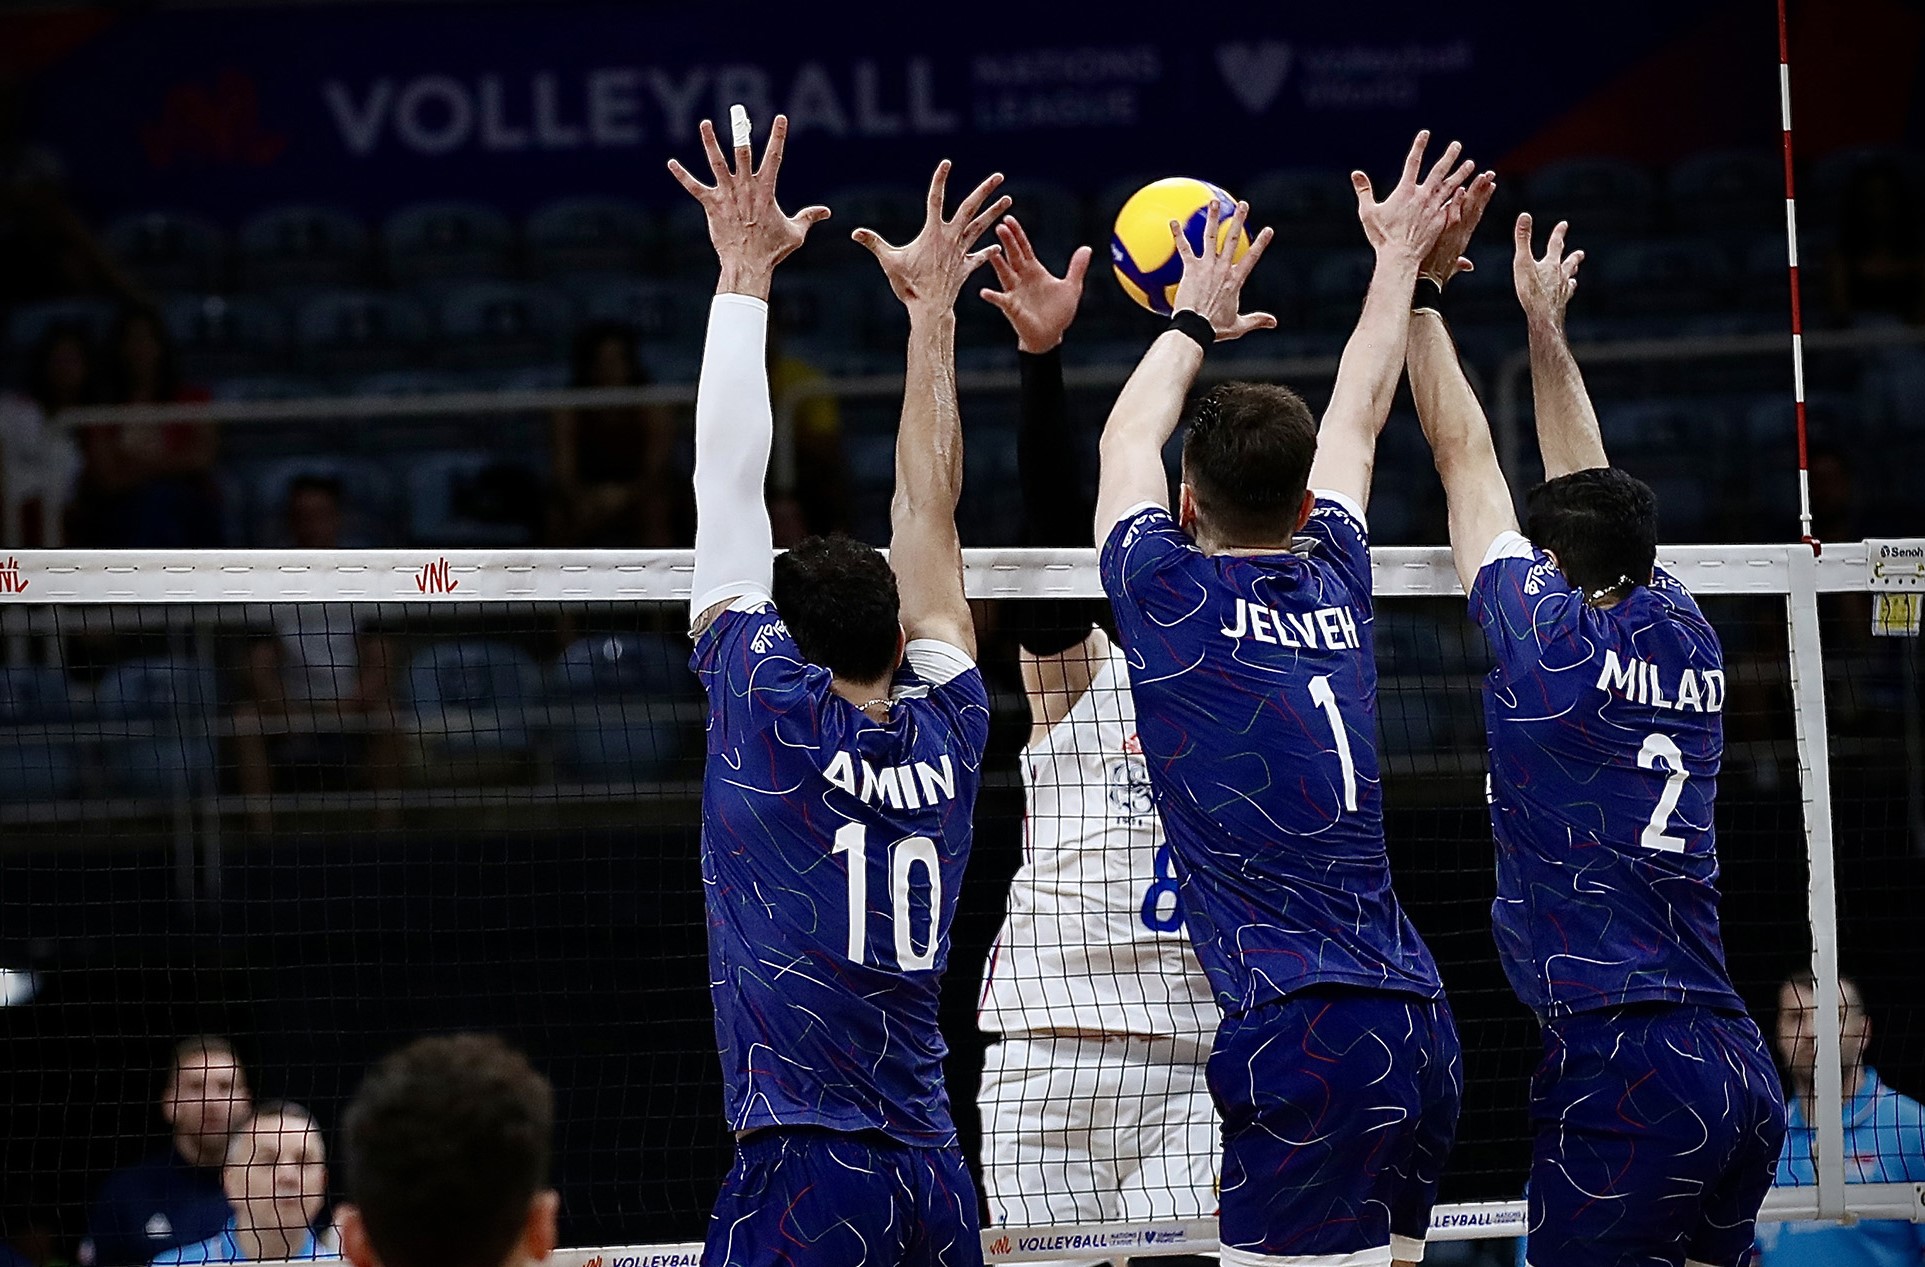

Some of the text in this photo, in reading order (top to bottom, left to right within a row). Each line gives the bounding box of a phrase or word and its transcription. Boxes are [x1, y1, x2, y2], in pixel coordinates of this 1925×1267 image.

[322, 56, 960, 158] VOLLEYBALL
[0, 556, 29, 593] NL
[415, 557, 459, 594] VNL
[1891, 546, 1923, 558] Senoh
[1220, 598, 1361, 650] JELVEH
[1596, 649, 1725, 713] MILAD
[1307, 675, 1358, 812] 1
[822, 750, 956, 809] AMIN
[1636, 732, 1690, 854] 2
[831, 821, 942, 972] 10
[1019, 1234, 1107, 1251] VOLLEYBALL
[1430, 1213, 1492, 1228] LEYBALL
[612, 1254, 700, 1267] VOLLEYBAL
